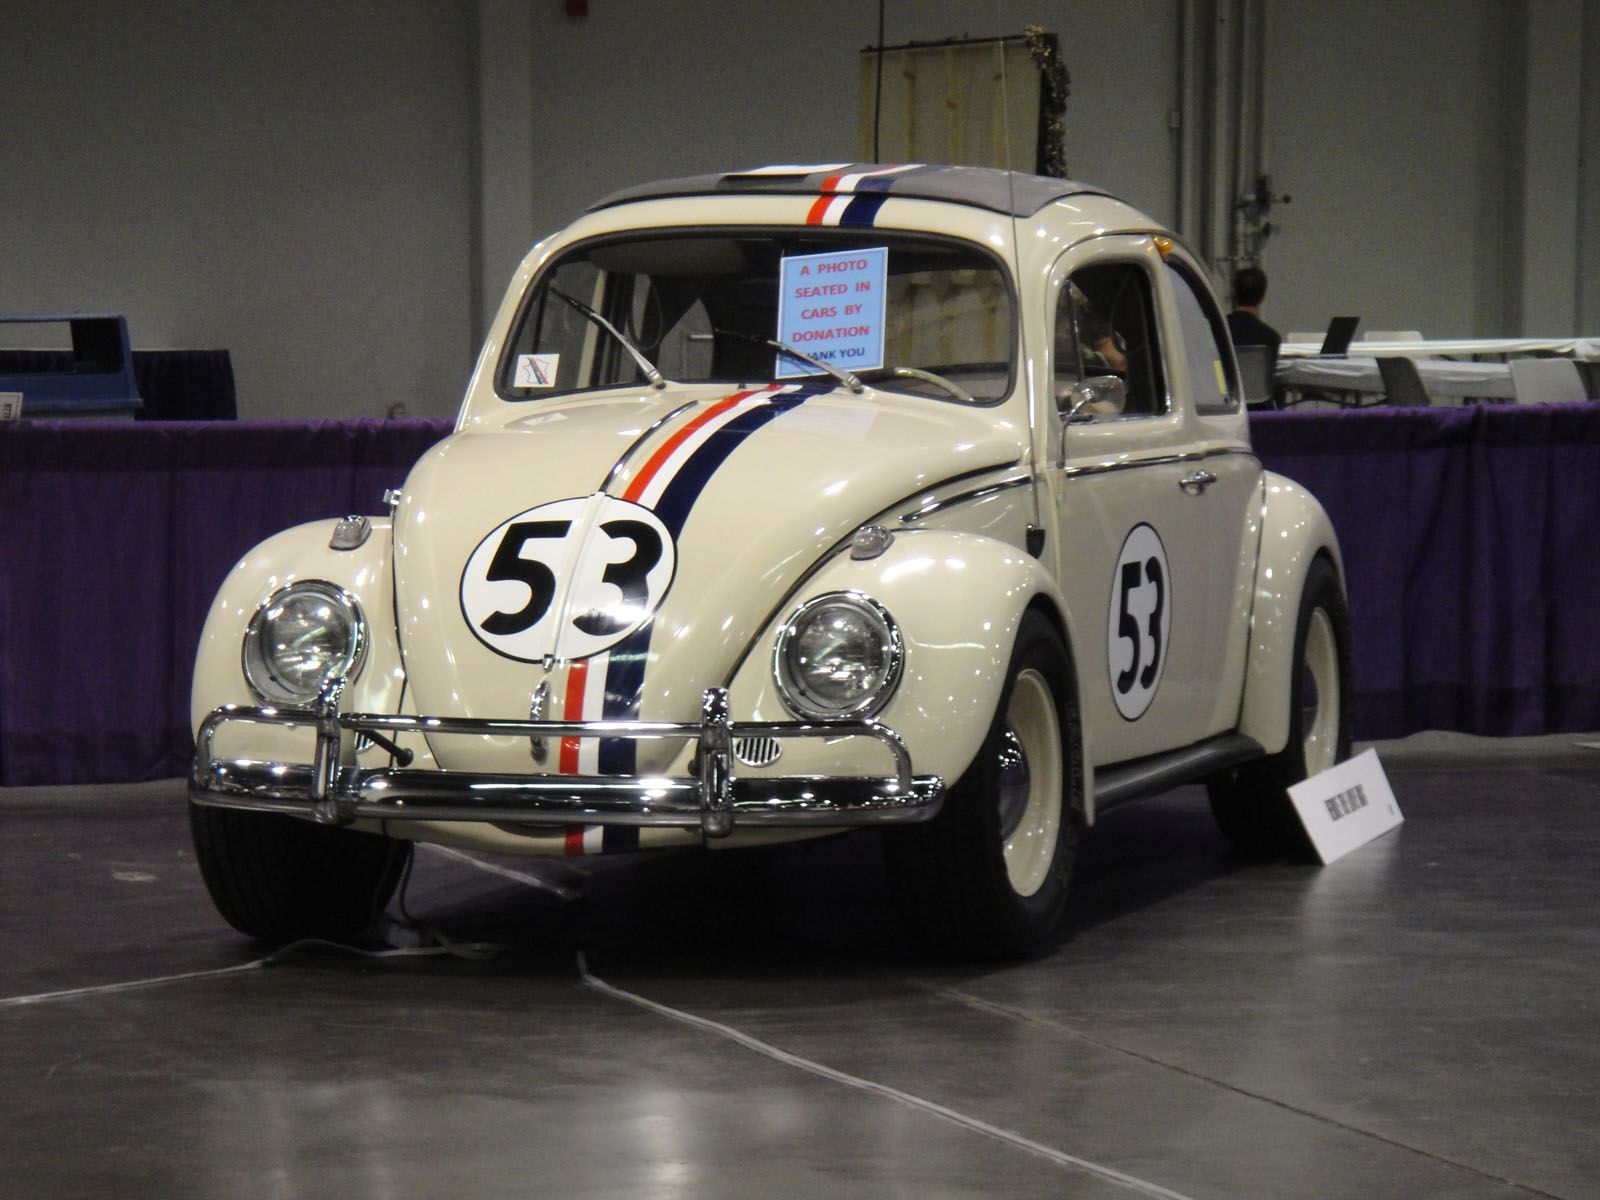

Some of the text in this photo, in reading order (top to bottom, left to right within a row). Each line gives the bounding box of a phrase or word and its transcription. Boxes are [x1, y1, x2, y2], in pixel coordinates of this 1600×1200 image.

[800, 259, 868, 276] A PHOTO
[795, 281, 871, 298] SEATED IN
[801, 303, 863, 320] CARS BY
[792, 326, 870, 342] DONATION
[803, 347, 865, 361] ANK YOU
[480, 519, 663, 637] 53
[1117, 556, 1164, 695] 53
